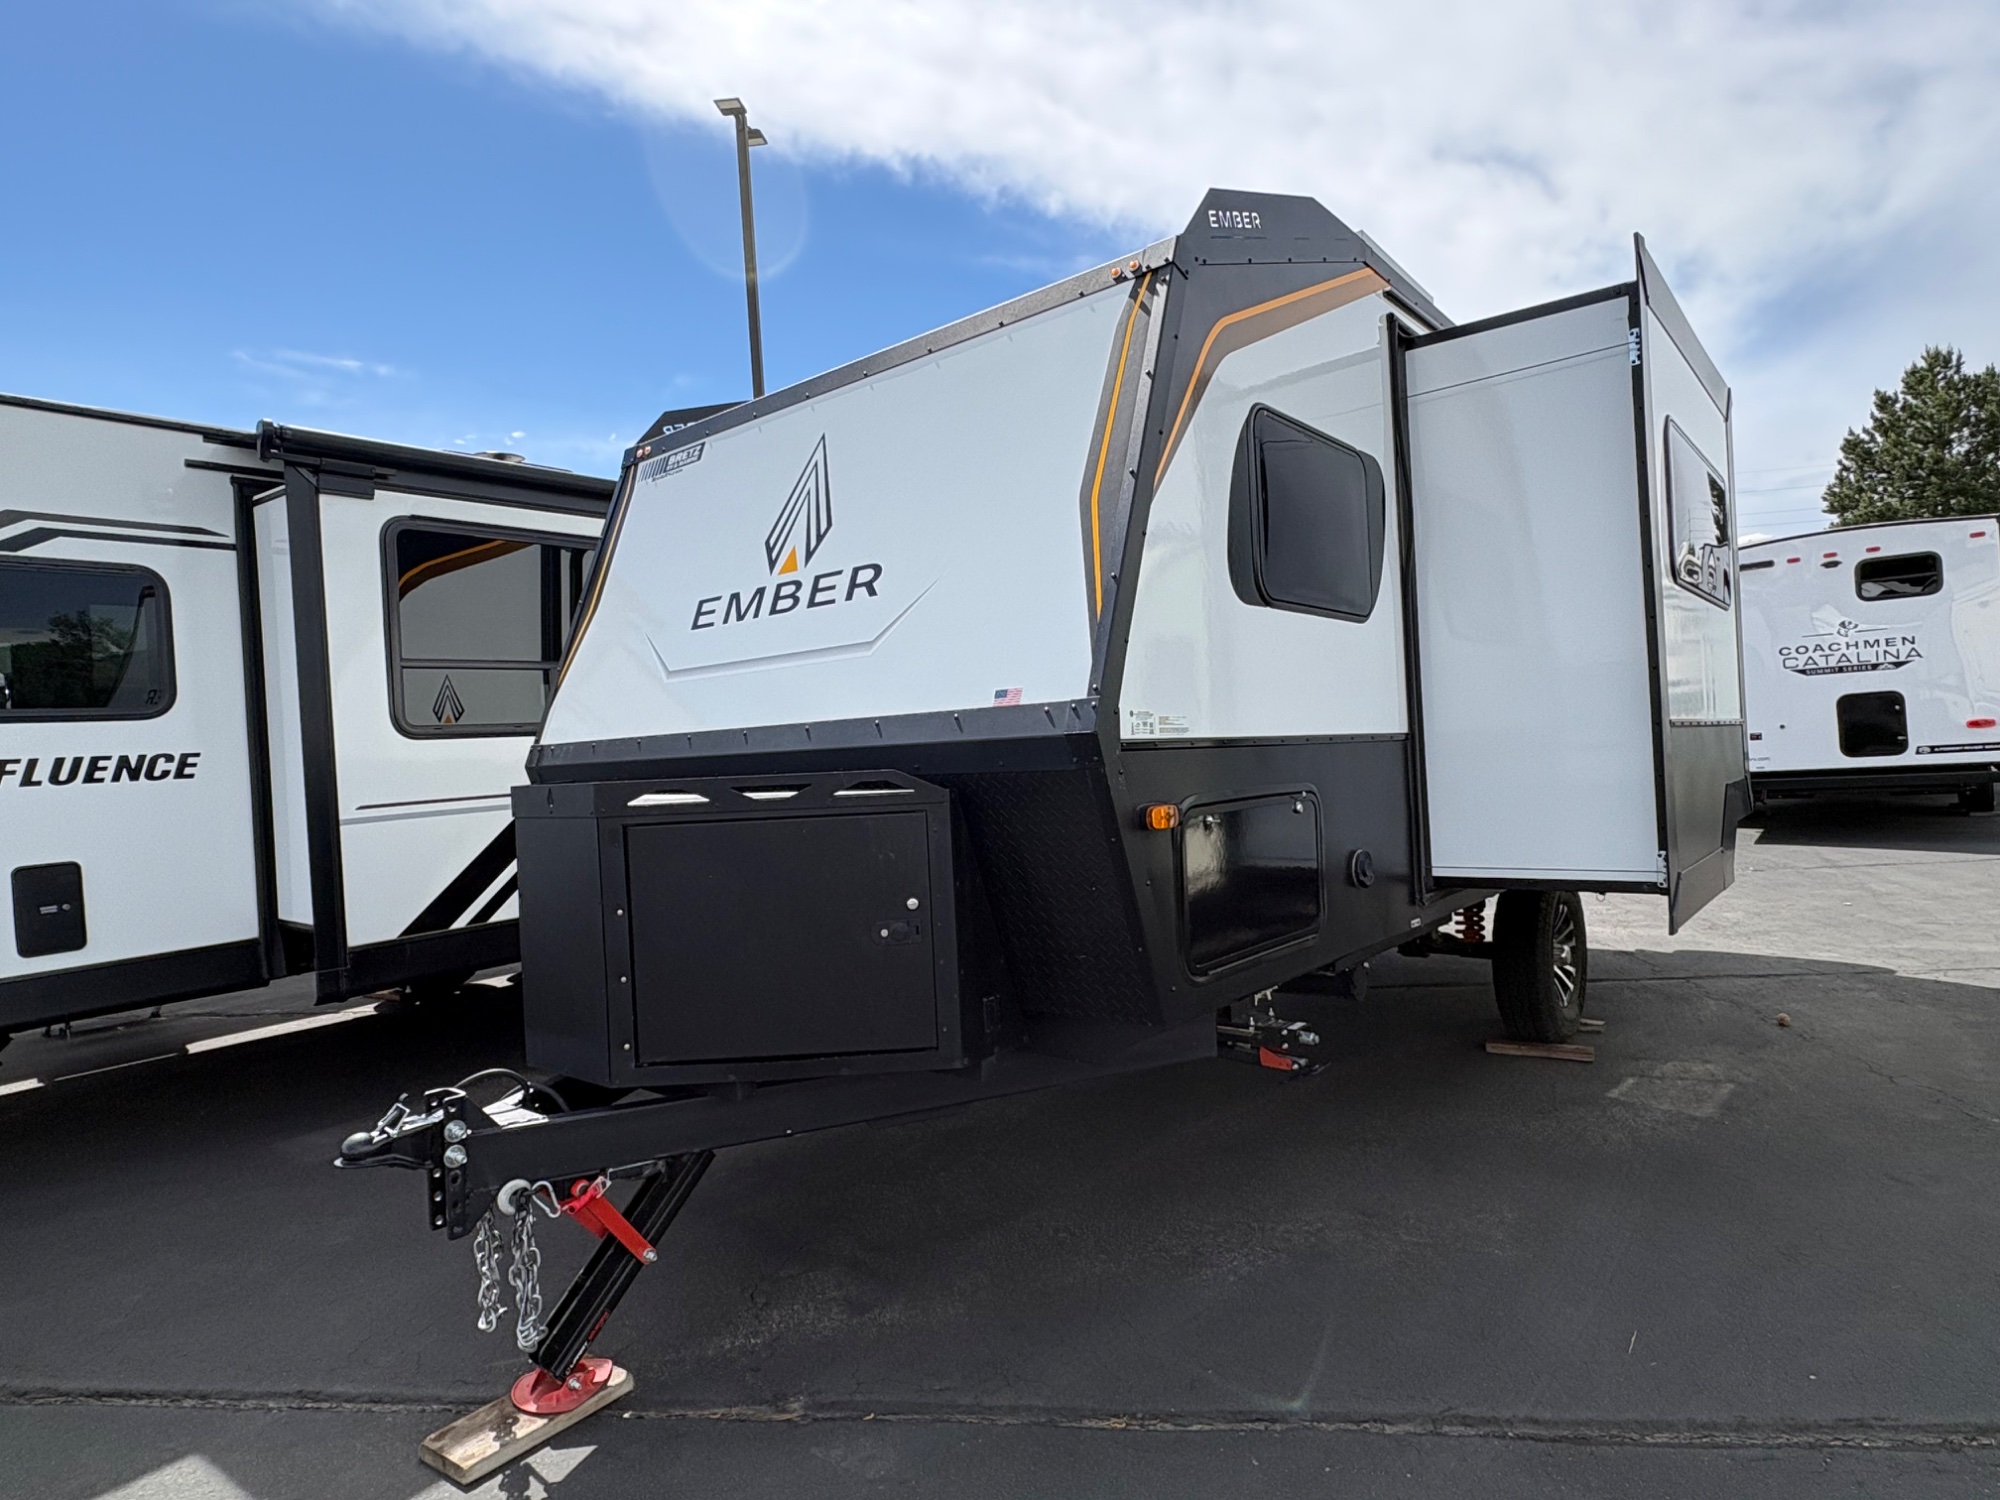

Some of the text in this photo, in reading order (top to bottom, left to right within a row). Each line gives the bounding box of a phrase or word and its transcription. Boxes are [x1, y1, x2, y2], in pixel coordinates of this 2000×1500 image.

[1208, 210, 1261, 229] EMBER
[669, 445, 702, 463] BRETZ
[691, 563, 883, 631] EMBER
[1778, 635, 1916, 657] COACHMEN
[1782, 647, 1924, 670] CATALINA
[1806, 664, 1873, 675] SUMMIT SERIES
[0, 752, 201, 787] FLUENCE
